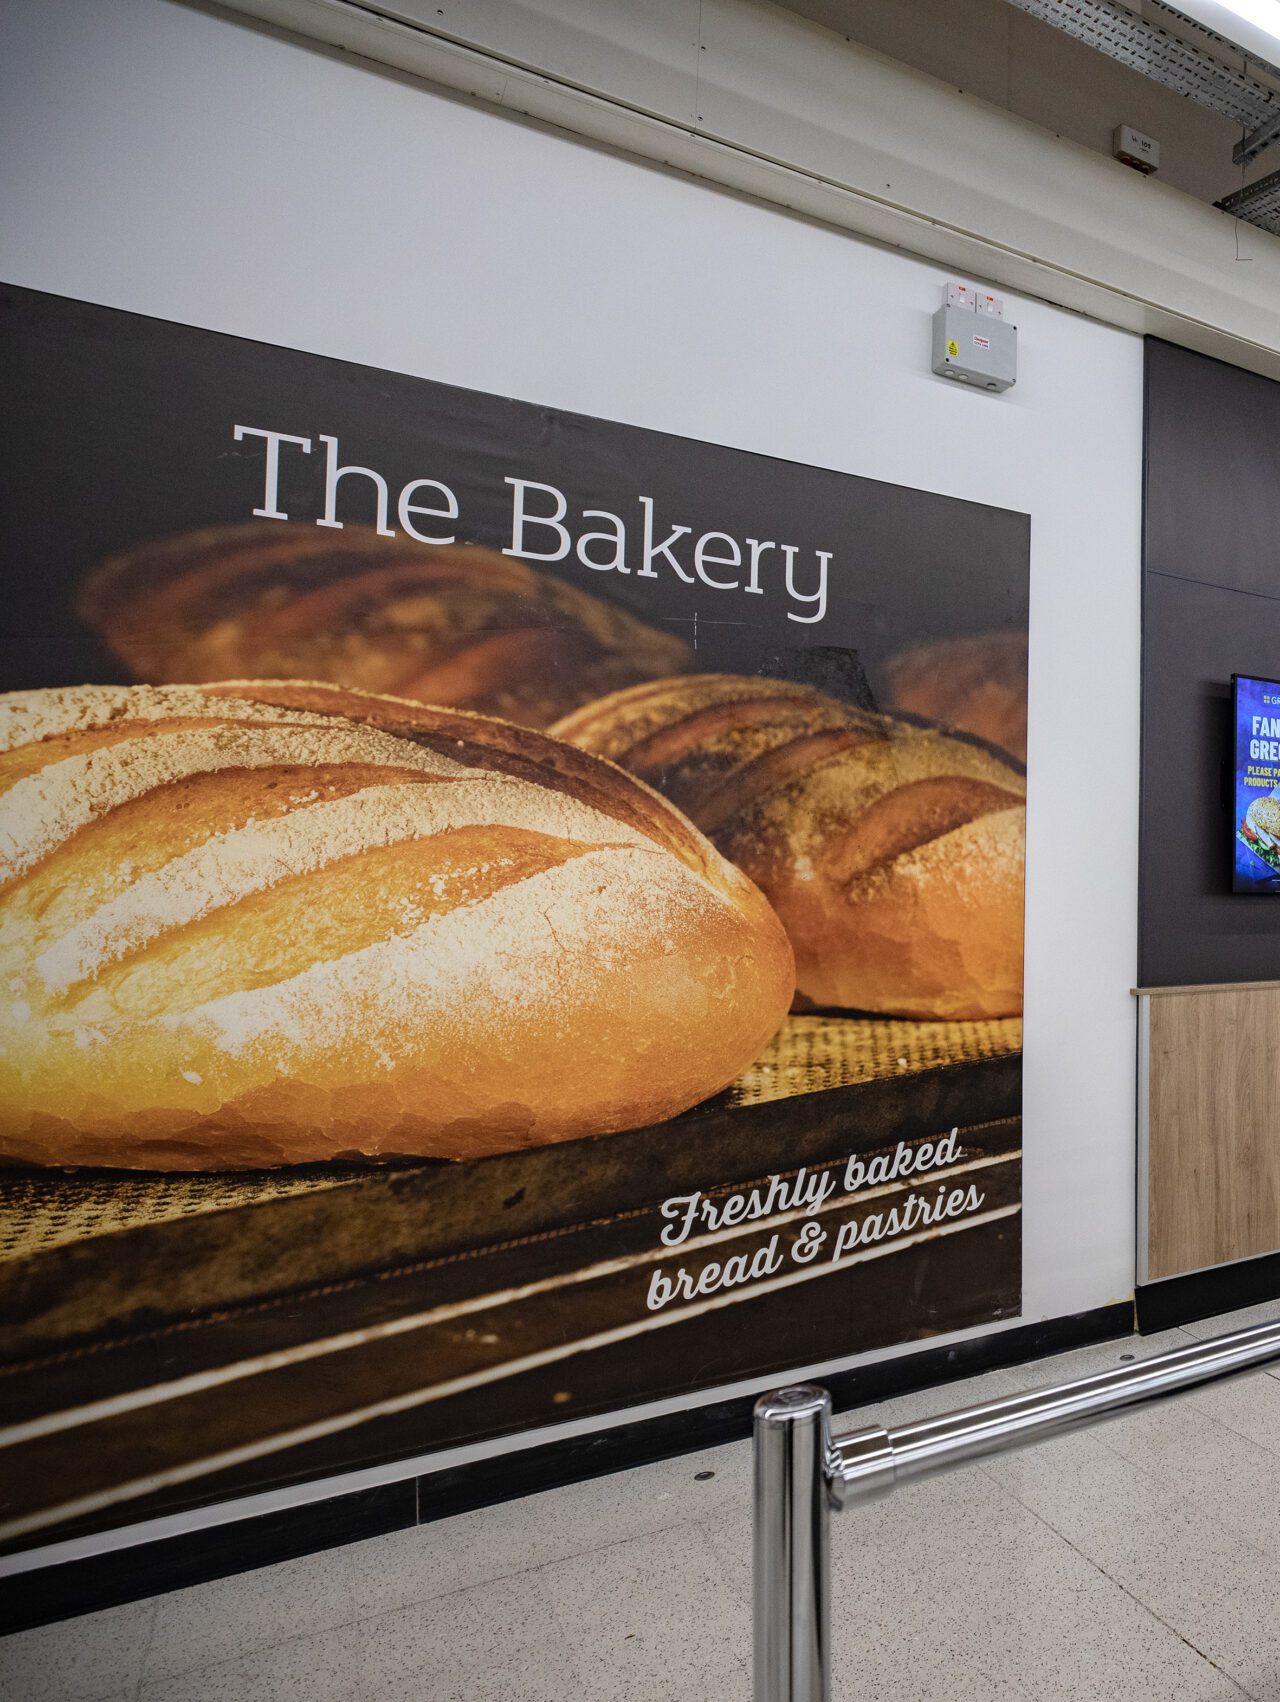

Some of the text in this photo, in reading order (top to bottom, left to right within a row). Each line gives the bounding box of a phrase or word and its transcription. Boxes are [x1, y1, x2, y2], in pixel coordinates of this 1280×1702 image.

[233, 424, 833, 624] The Bakery
[1244, 776, 1277, 788] PRODUCTS
[1247, 766, 1272, 776] PLEASE
[646, 1184, 985, 1310] bread & pastries
[660, 1127, 964, 1247] Freshly baked
